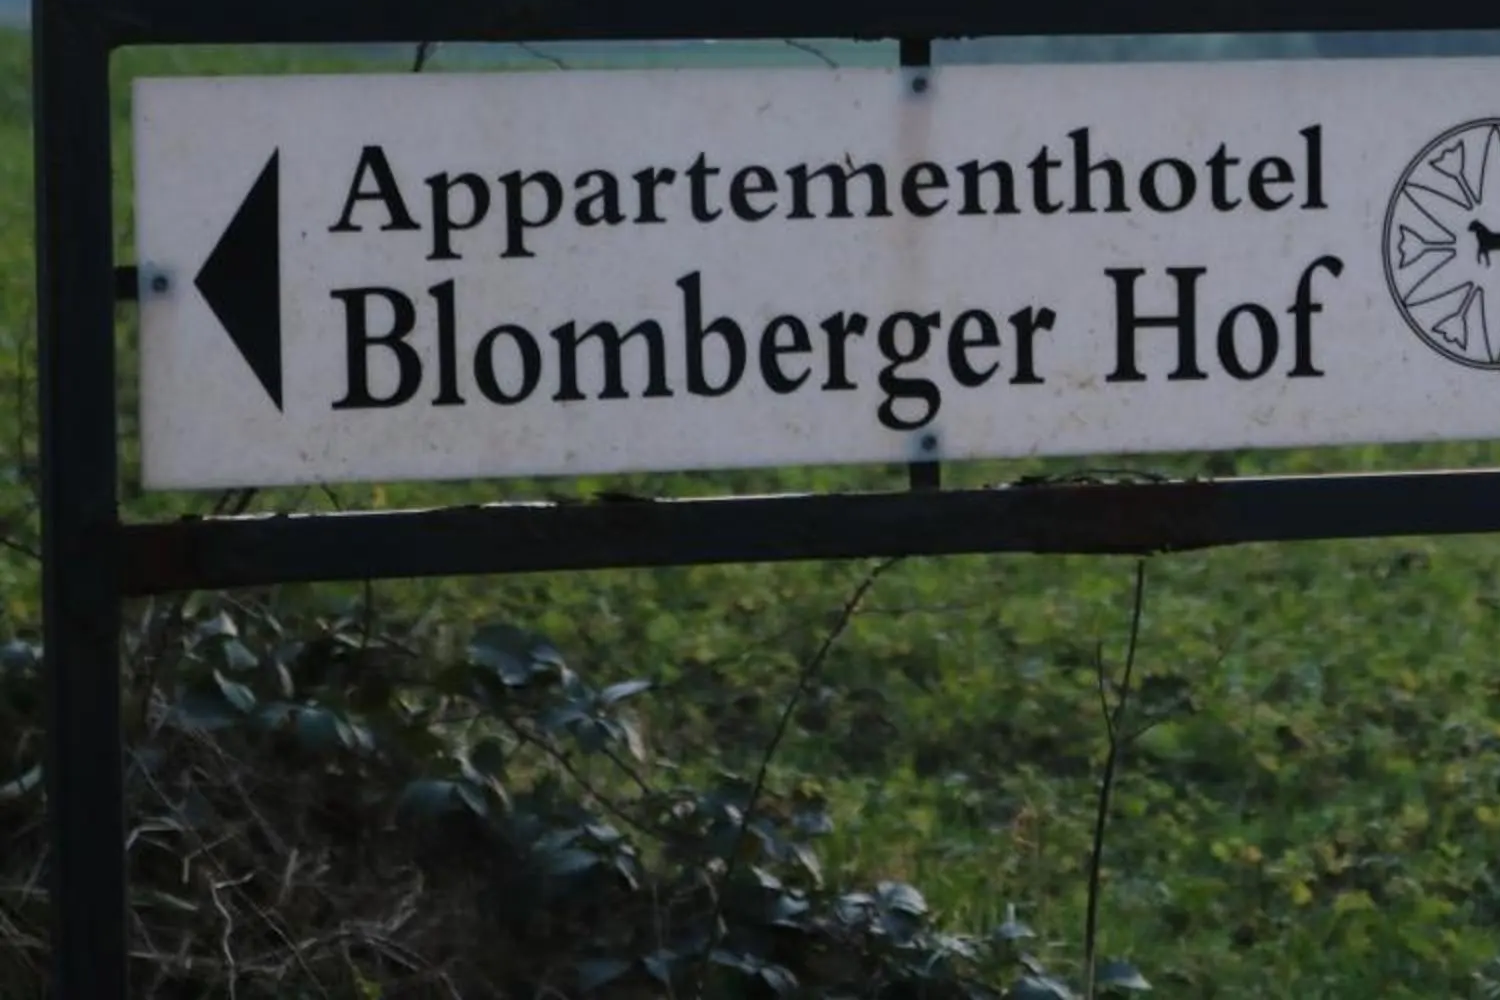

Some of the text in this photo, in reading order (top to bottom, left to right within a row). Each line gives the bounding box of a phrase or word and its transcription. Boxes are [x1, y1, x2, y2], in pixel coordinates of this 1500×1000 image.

[327, 123, 1329, 262] Appartementhotel
[329, 254, 1345, 431] Blomberger Hof
